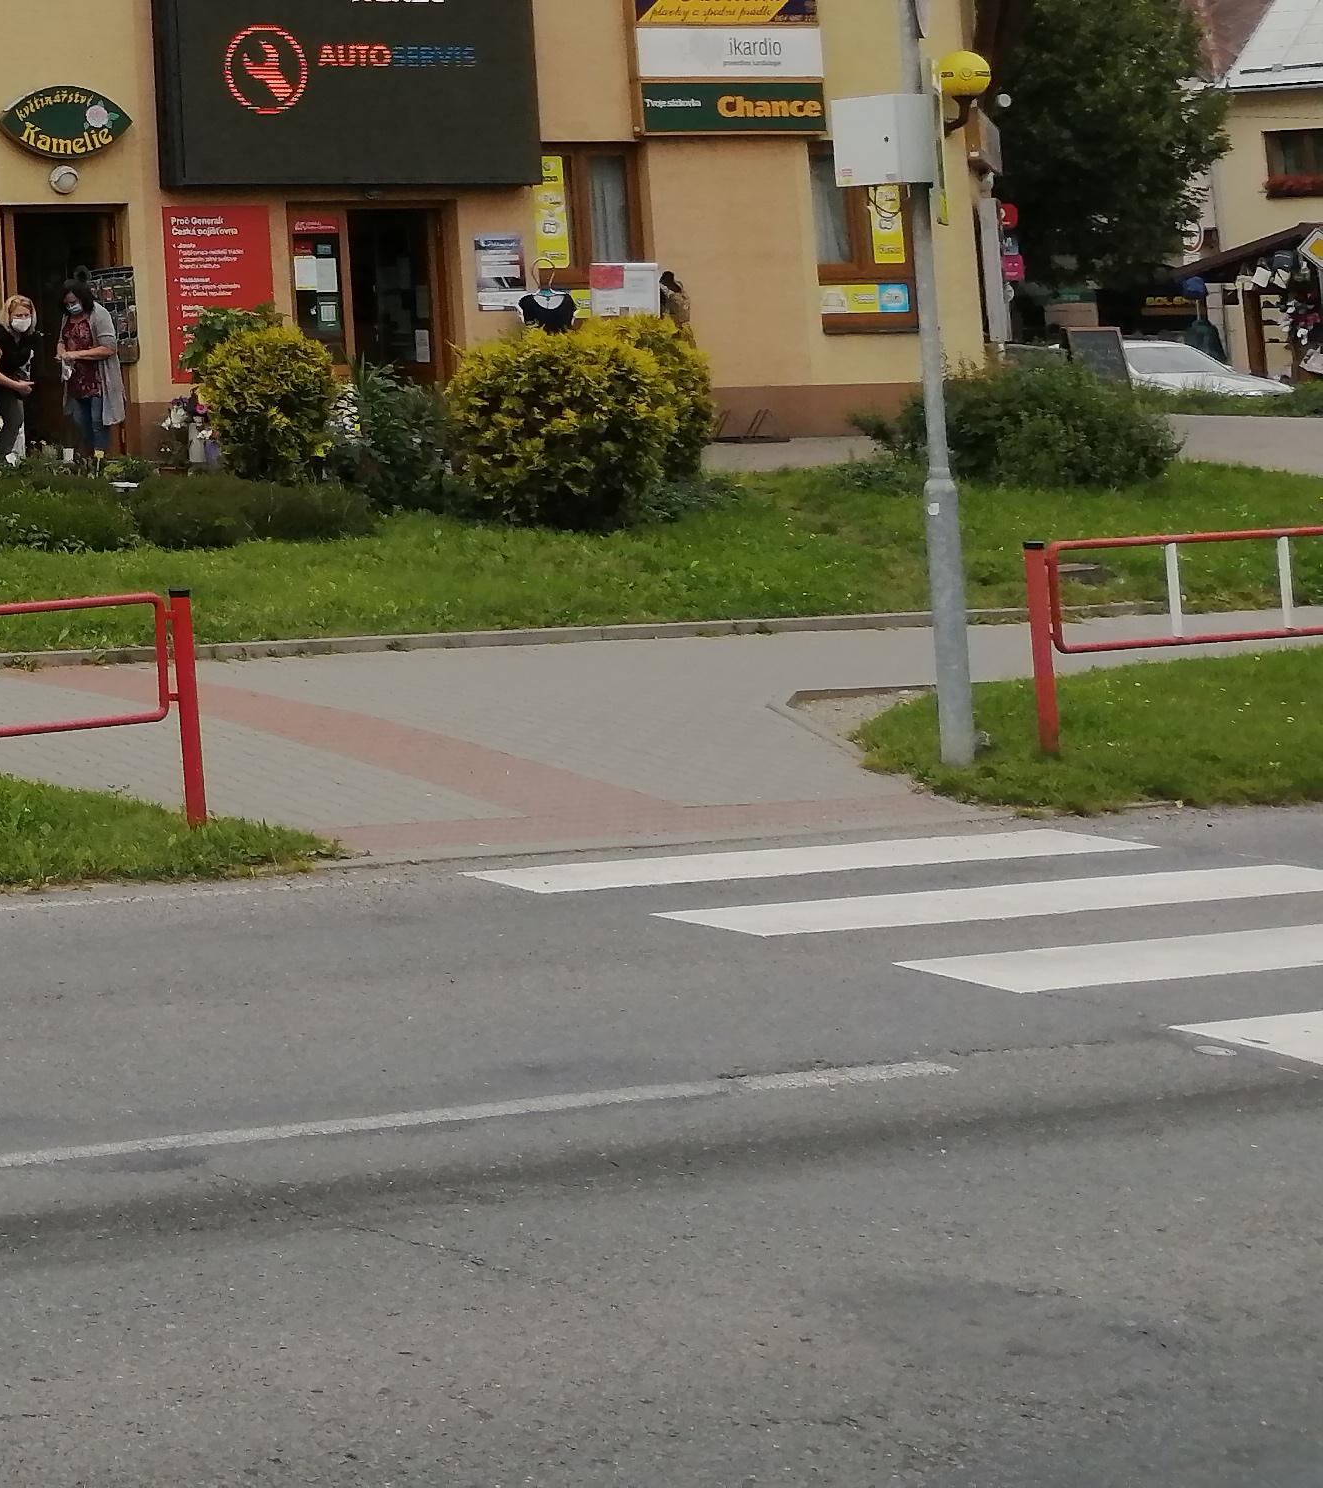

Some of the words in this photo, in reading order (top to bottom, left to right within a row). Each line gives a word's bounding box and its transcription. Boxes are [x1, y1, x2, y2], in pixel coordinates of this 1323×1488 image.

[729, 37, 782, 56] ikardio
[717, 95, 822, 118] Chance
[19, 121, 113, 155] Kamelie
